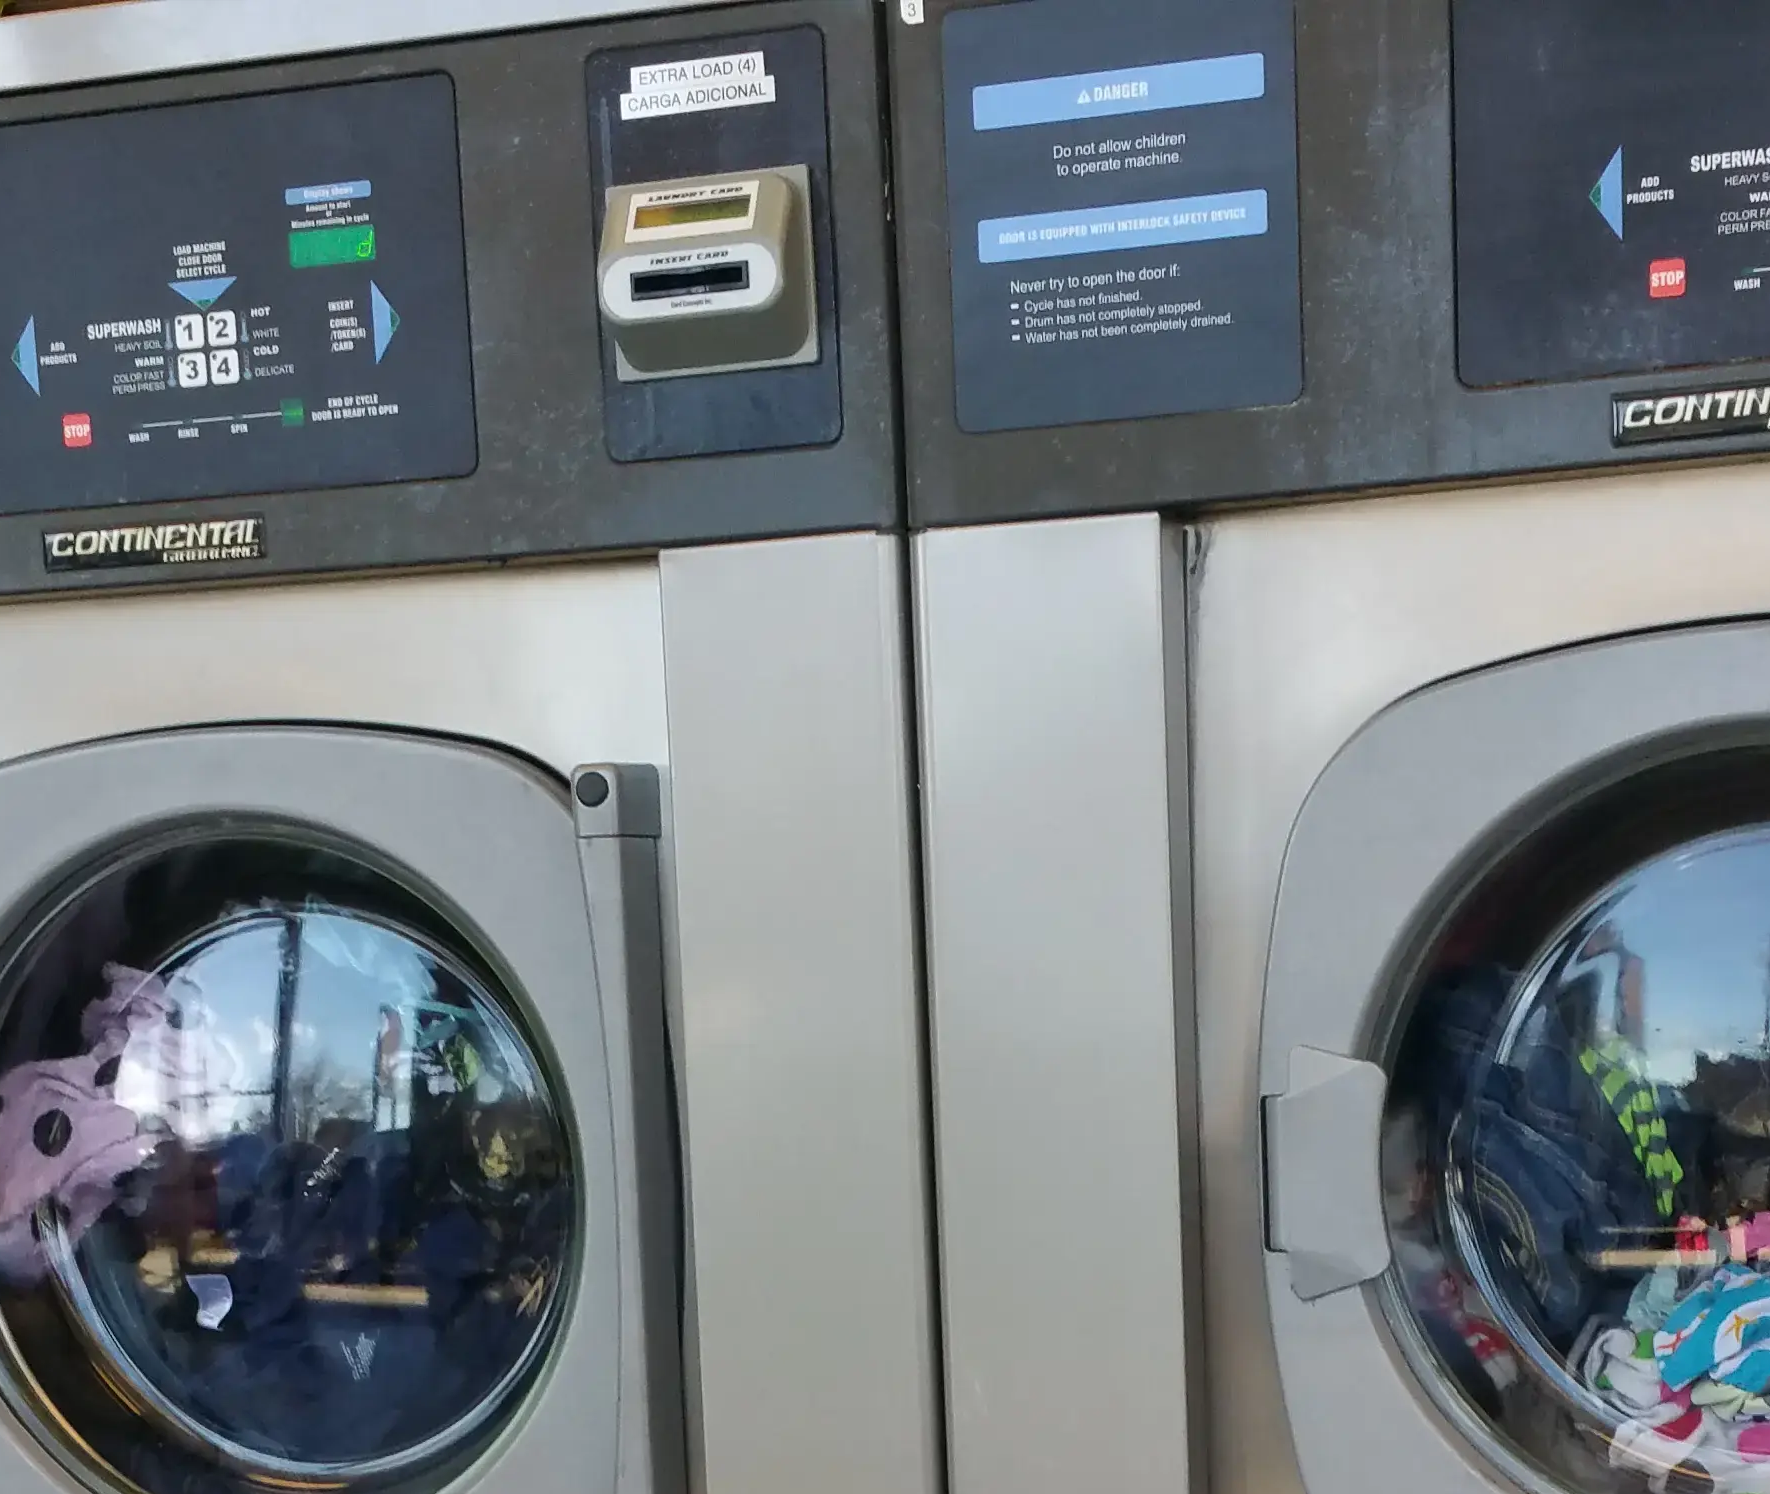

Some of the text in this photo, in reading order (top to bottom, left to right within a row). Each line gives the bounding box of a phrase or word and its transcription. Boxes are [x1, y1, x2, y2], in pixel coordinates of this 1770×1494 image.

[907, 3, 917, 17] 3
[639, 58, 757, 86] EXTRA LOAD (4)
[628, 82, 767, 112] CARGA ADICIONAL
[1093, 81, 1149, 102] DANGER
[1053, 133, 1185, 159] Do not allow children
[1057, 152, 1182, 176] to operate machine.
[1641, 176, 1660, 188] ADD
[1725, 173, 1760, 186] HEAVY
[648, 186, 744, 202] LAUNDRY CARD
[1626, 189, 1675, 205] PRODUCTS
[1720, 208, 1758, 222] COLOR
[999, 207, 1246, 244] DOOR IS EQUIPPED WITH INTERLOCK SAFETY DEVICE
[1718, 223, 1748, 235] PERM
[173, 240, 226, 256] LOAD MACHINE
[178, 255, 201, 266] CLOSE
[650, 250, 729, 265] INSERT CARD
[176, 264, 226, 279] SELECT CYCLE
[1651, 270, 1684, 288] STOP
[1010, 280, 1046, 294] Never
[1049, 278, 1064, 292] try
[1068, 275, 1079, 288] to
[1082, 273, 1112, 289] open
[1116, 269, 1135, 283] the
[1138, 266, 1166, 281] door
[1734, 278, 1761, 291] WASH
[1024, 290, 1143, 314] Cycle has not finished.
[251, 306, 271, 318] HOT
[1024, 315, 1053, 328] Drum
[1057, 313, 1076, 325] has
[1079, 311, 1095, 322] not
[1098, 304, 1155, 321] completely
[87, 318, 162, 340] SUPERWASH
[183, 318, 229, 341] 1 2
[253, 327, 279, 339] WHITE
[1025, 312, 1234, 344] Water has not been completely drained.
[114, 342, 141, 353] HEAVY
[253, 345, 279, 357] COLD
[135, 357, 164, 368] WARM
[186, 356, 232, 380] 3 4
[255, 364, 295, 378] DELICATE
[64, 424, 91, 438] STOP
[51, 518, 259, 557] CONTINENTAL
